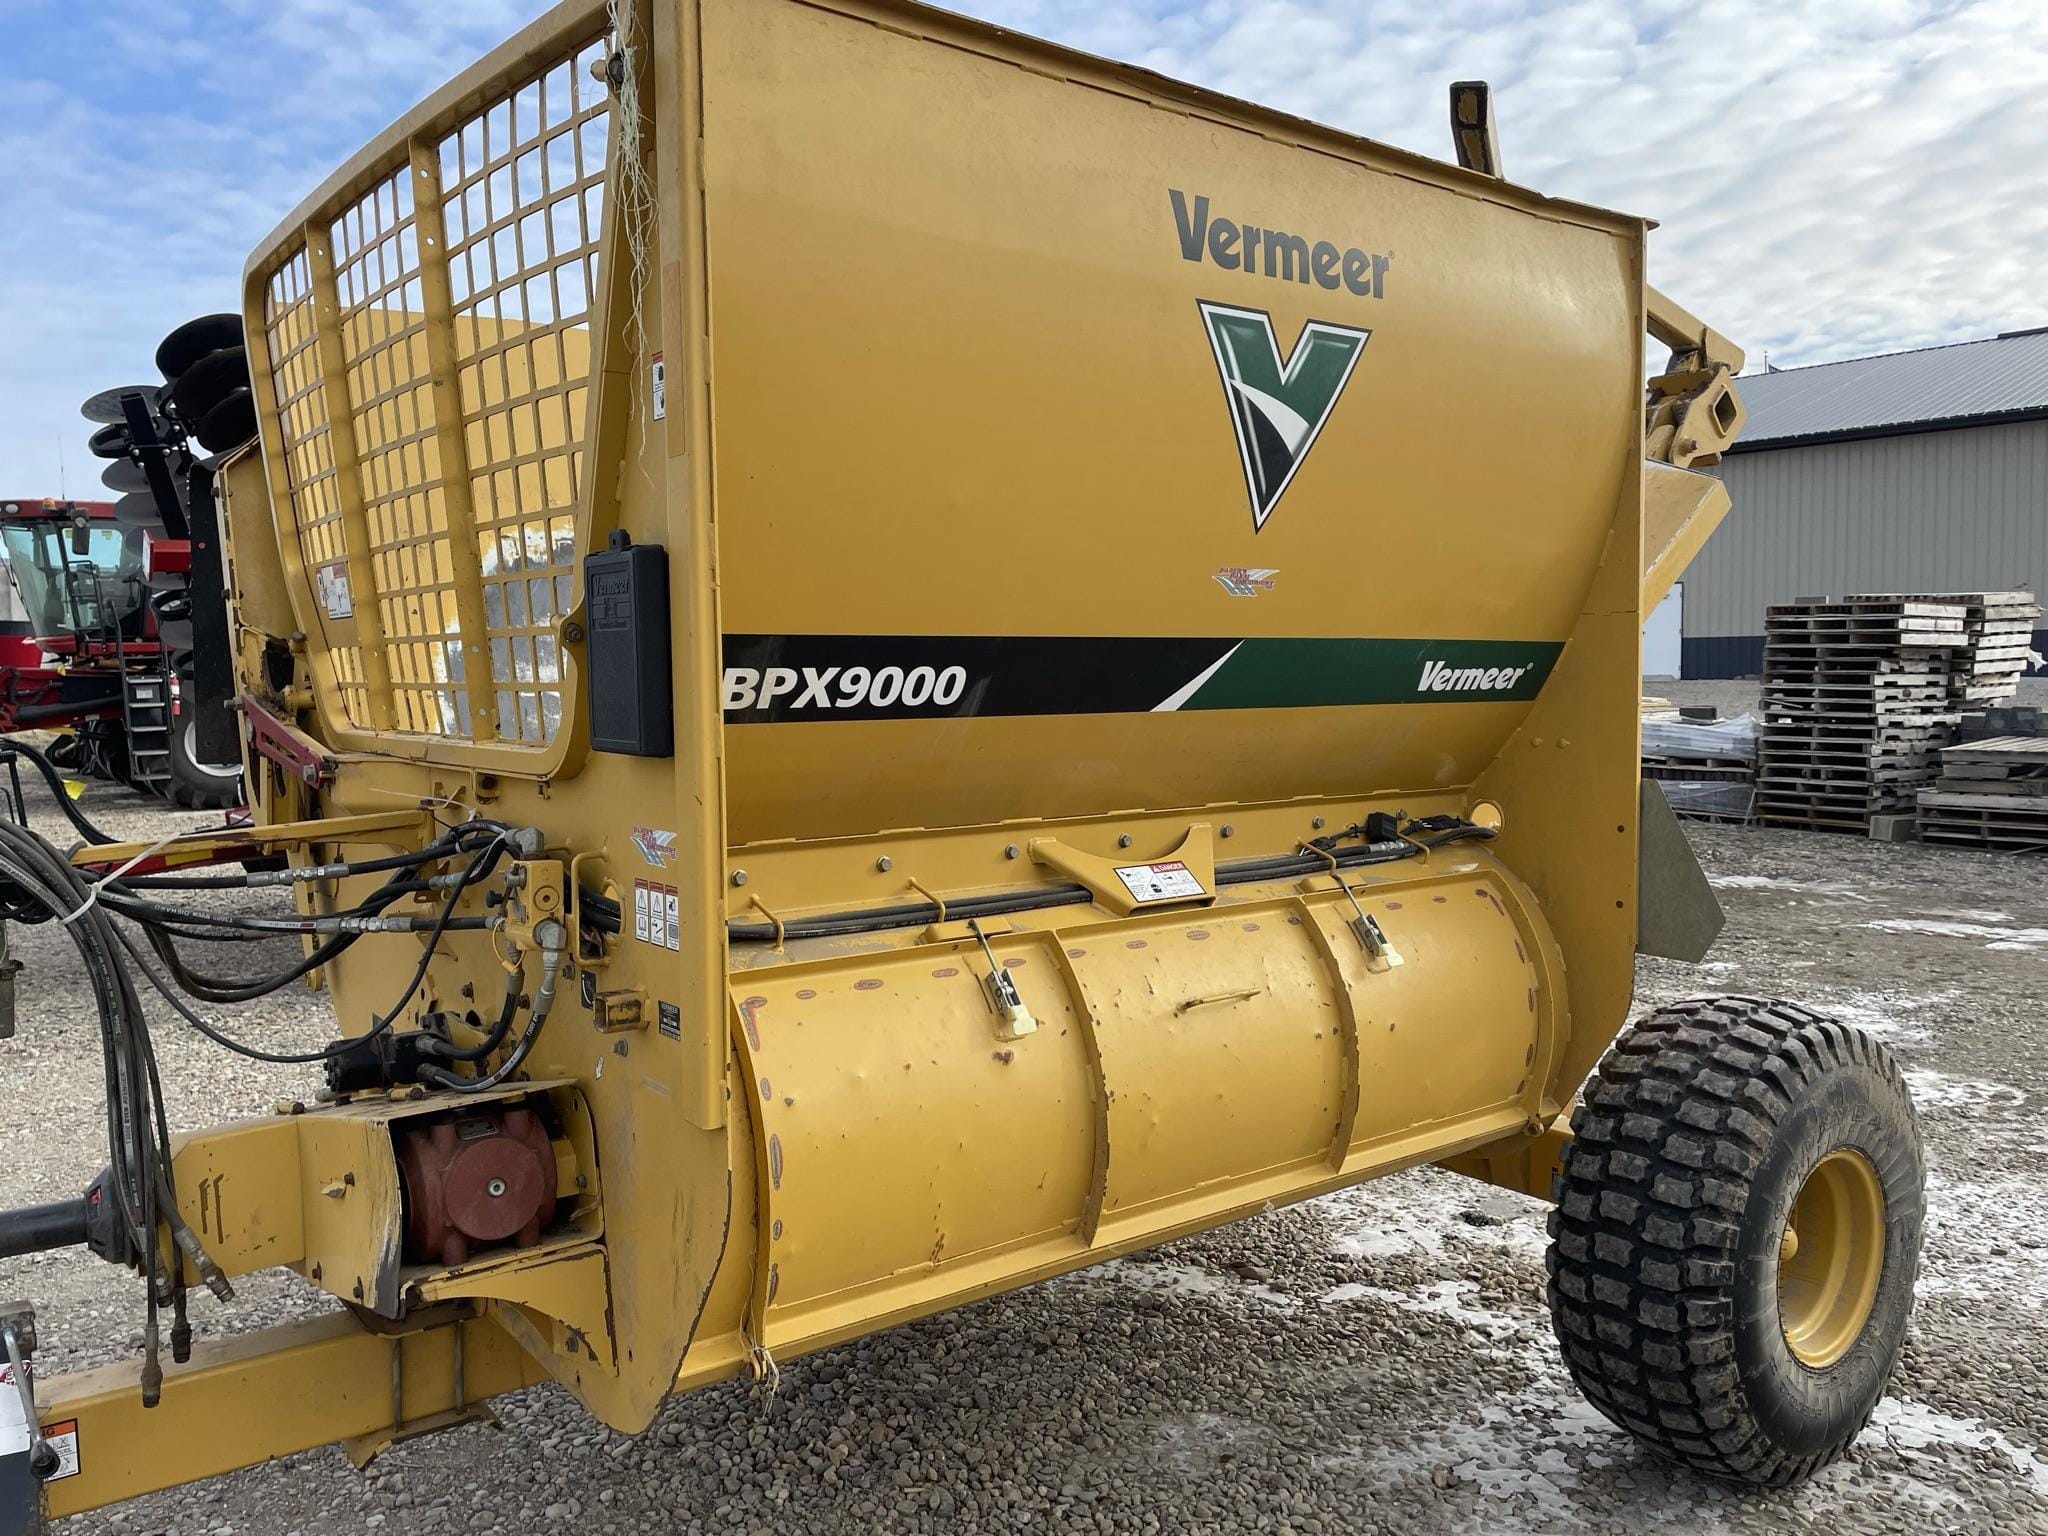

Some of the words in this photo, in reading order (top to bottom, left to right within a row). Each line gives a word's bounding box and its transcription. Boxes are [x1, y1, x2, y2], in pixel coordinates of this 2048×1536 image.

[1168, 188, 1390, 299] Vermeer
[592, 575, 629, 595] Vermeer
[723, 665, 967, 710] BPX9000
[1417, 661, 1526, 691] Vermeer
[154, 904, 190, 917] DIEHARD
